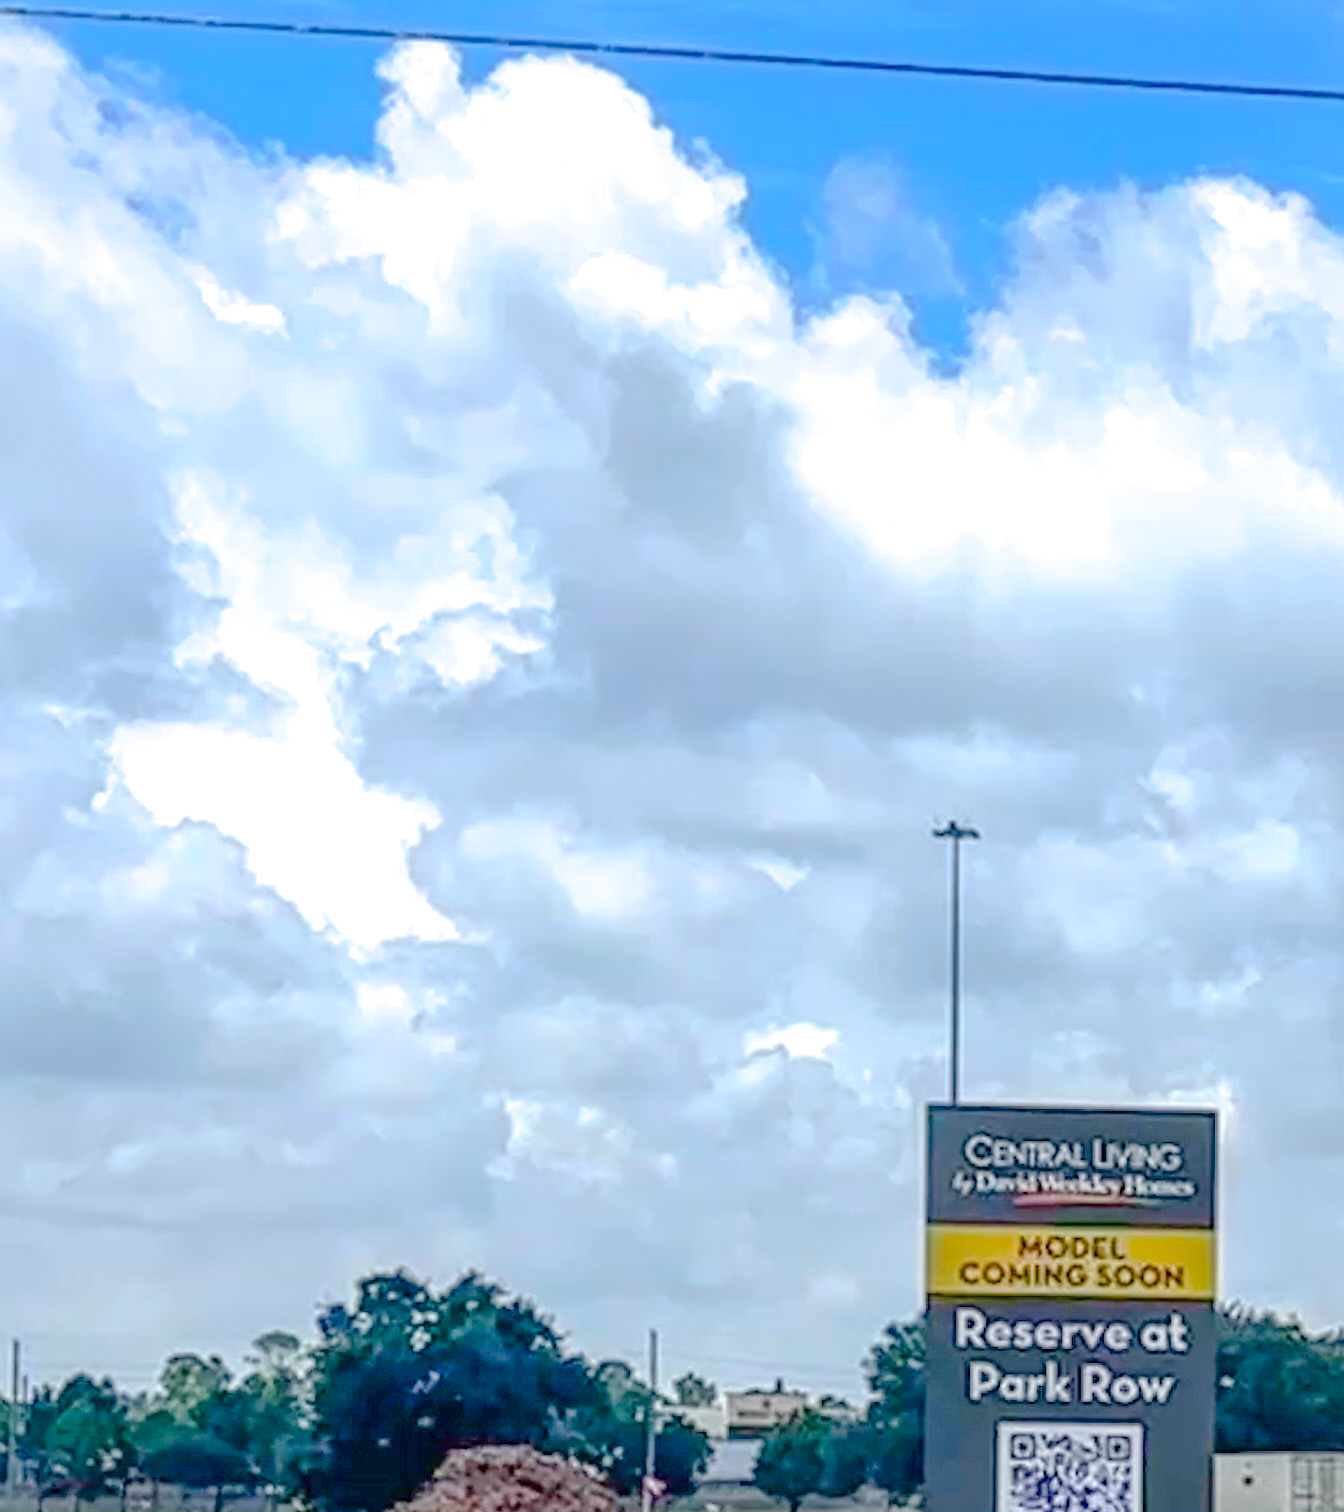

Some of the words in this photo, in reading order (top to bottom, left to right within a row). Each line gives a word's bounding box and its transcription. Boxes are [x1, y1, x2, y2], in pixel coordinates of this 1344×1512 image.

[965, 1134, 1087, 1168] CENTRAL
[1092, 1138, 1182, 1172] LIVING
[1018, 1235, 1126, 1260] MODEL
[959, 1263, 1087, 1287] COMING
[1097, 1265, 1184, 1287] SOON
[955, 1308, 1132, 1350] Reserve
[1141, 1314, 1189, 1351] at
[969, 1361, 1070, 1401] Park
[1081, 1364, 1176, 1402] Row
